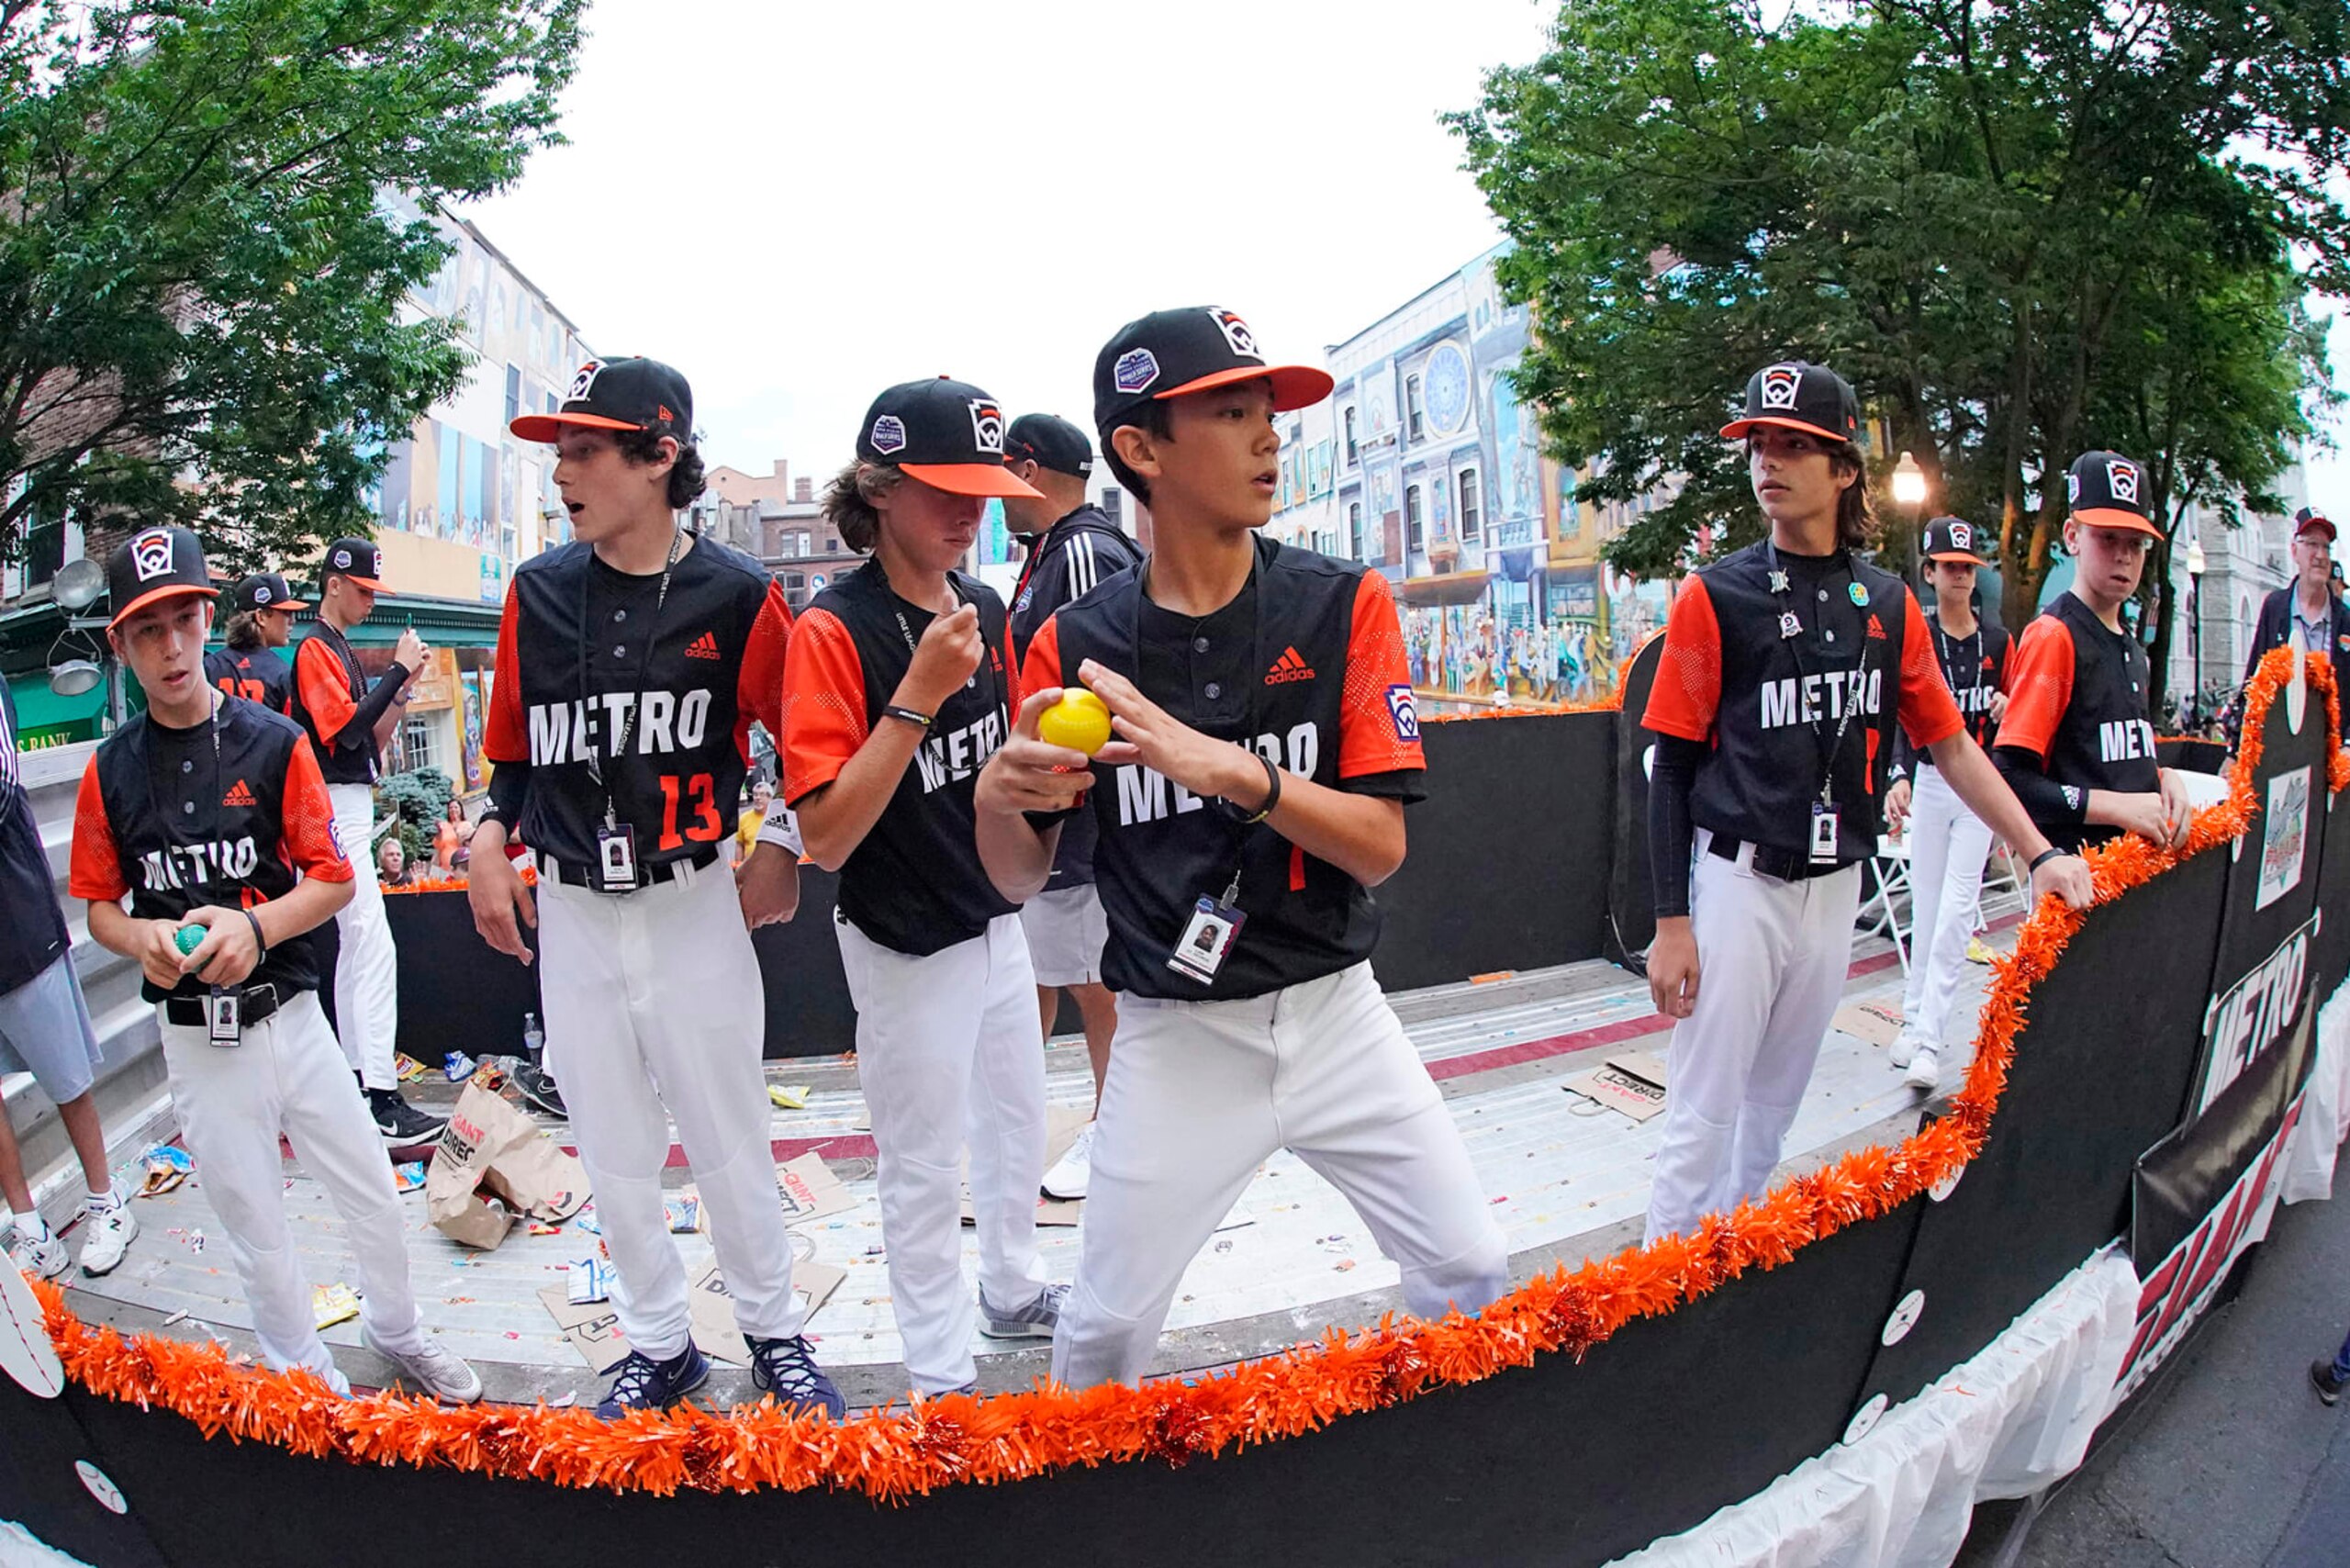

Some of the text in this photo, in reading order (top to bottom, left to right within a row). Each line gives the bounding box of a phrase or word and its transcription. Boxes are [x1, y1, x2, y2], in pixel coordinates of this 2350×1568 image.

[684, 647, 721, 660] adidas
[1264, 668, 1315, 686] adidas
[1762, 668, 1882, 729] METRO
[529, 689, 712, 767] METRO
[222, 797, 258, 807] adidas
[658, 773, 723, 852] 13
[139, 836, 259, 892] METRO
[2199, 933, 2307, 1116] METRO
